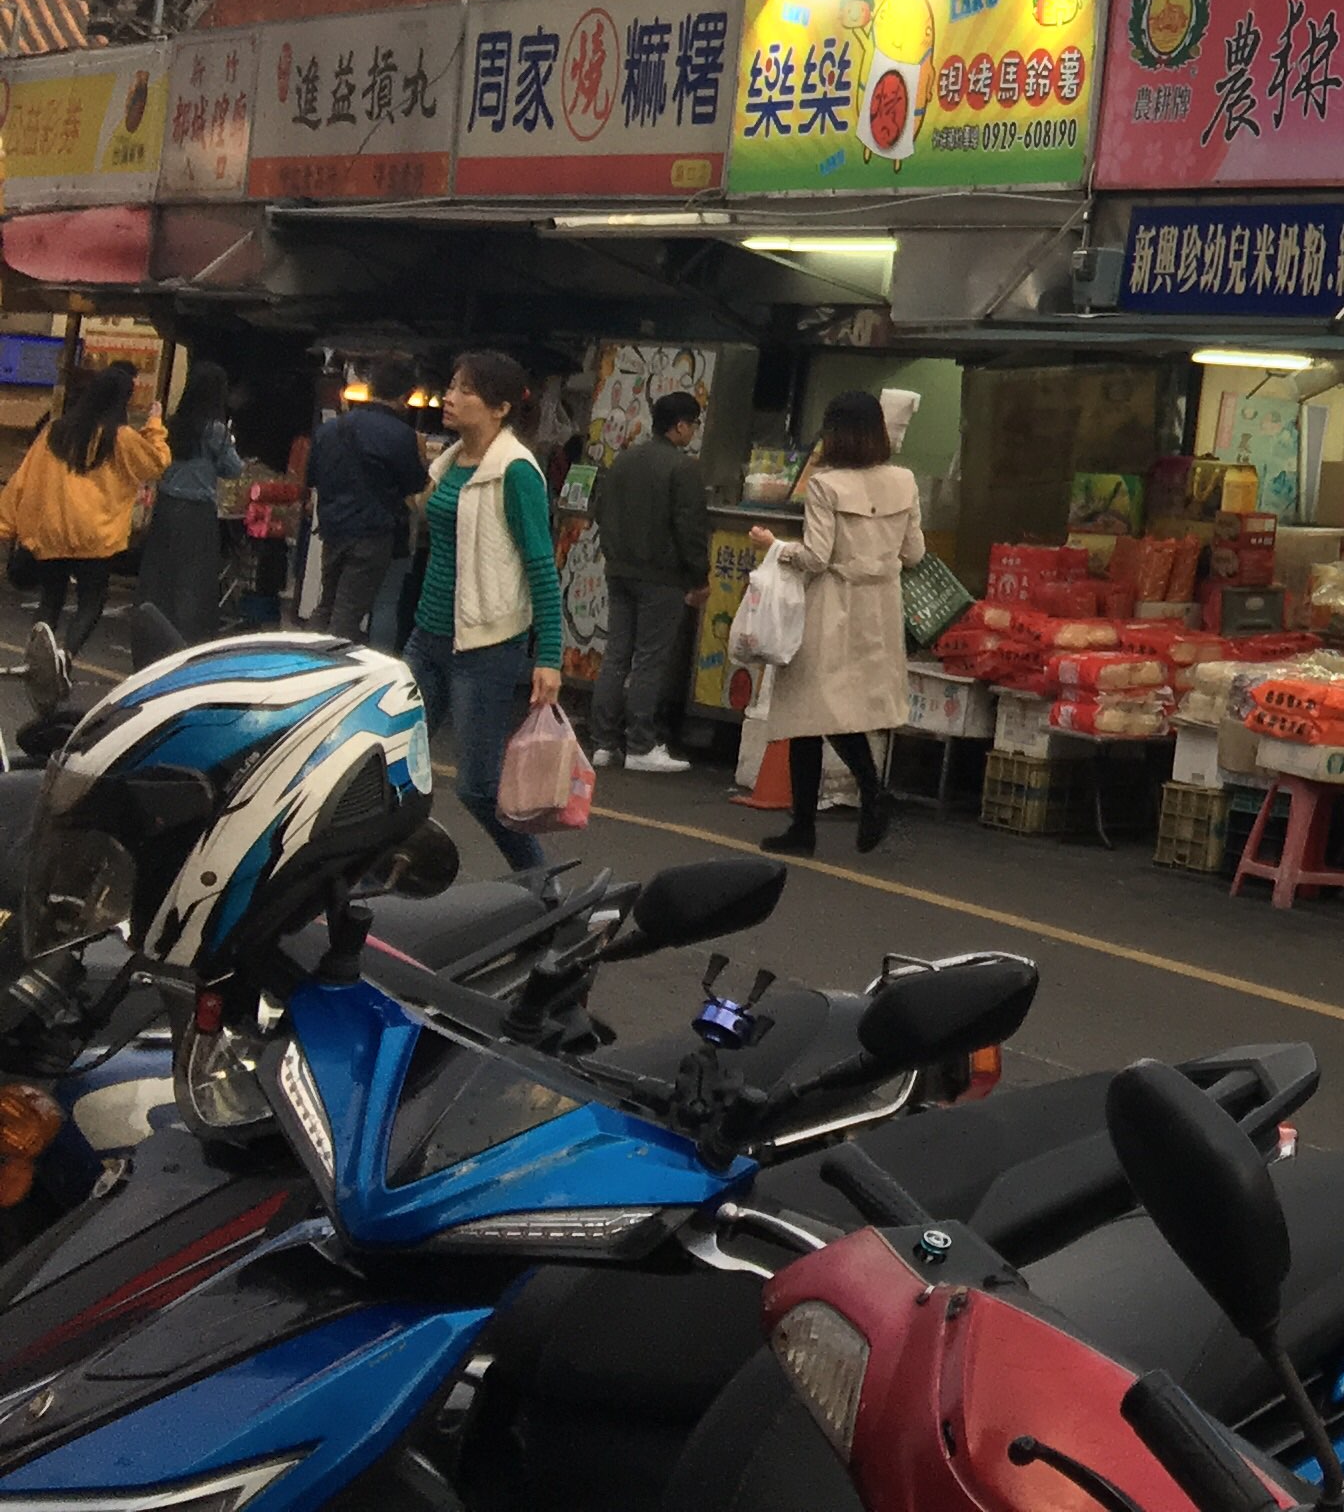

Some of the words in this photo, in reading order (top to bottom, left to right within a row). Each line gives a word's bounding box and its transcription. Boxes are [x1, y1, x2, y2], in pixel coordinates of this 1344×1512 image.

[744, 37, 852, 138] 樂樂
[938, 48, 1084, 104] 現烤馬鈴薯
[982, 119, 1076, 152] 0929-608190
